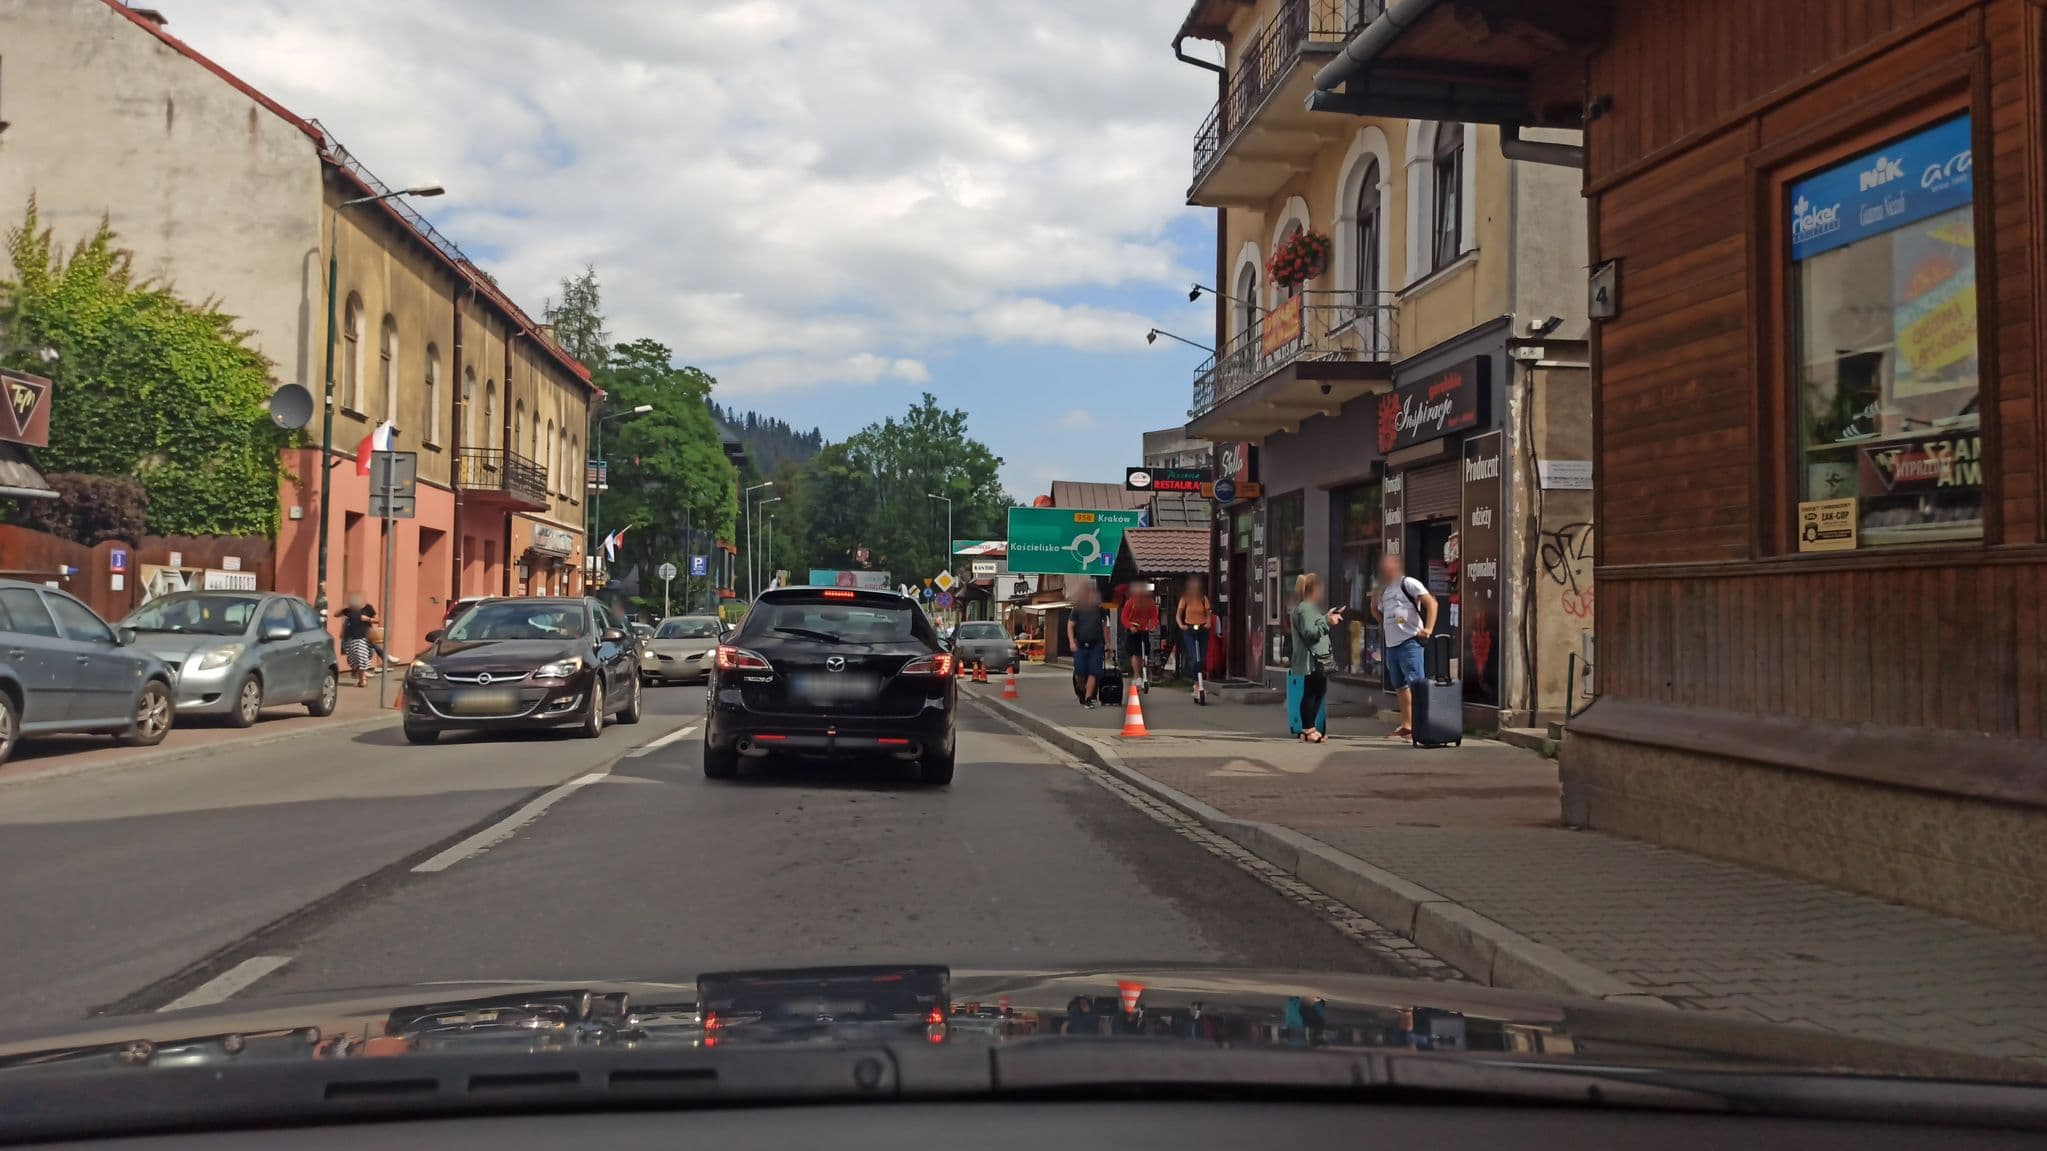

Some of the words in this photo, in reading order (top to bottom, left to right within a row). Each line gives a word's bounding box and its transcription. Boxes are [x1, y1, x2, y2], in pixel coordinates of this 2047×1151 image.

[1792, 198, 1841, 234] rieker
[1595, 286, 1608, 304] 4
[1394, 393, 1453, 438] Inspiracje
[1465, 454, 1500, 483] Producent
[1895, 455, 1952, 478] WYPRZED
[1153, 479, 1201, 491] RESTAURA
[1098, 514, 1131, 524] Kraków
[1821, 511, 1849, 521] ZAK-COP
[1010, 543, 1060, 552] Kościelisko
[1467, 558, 1497, 582] regionalnej
